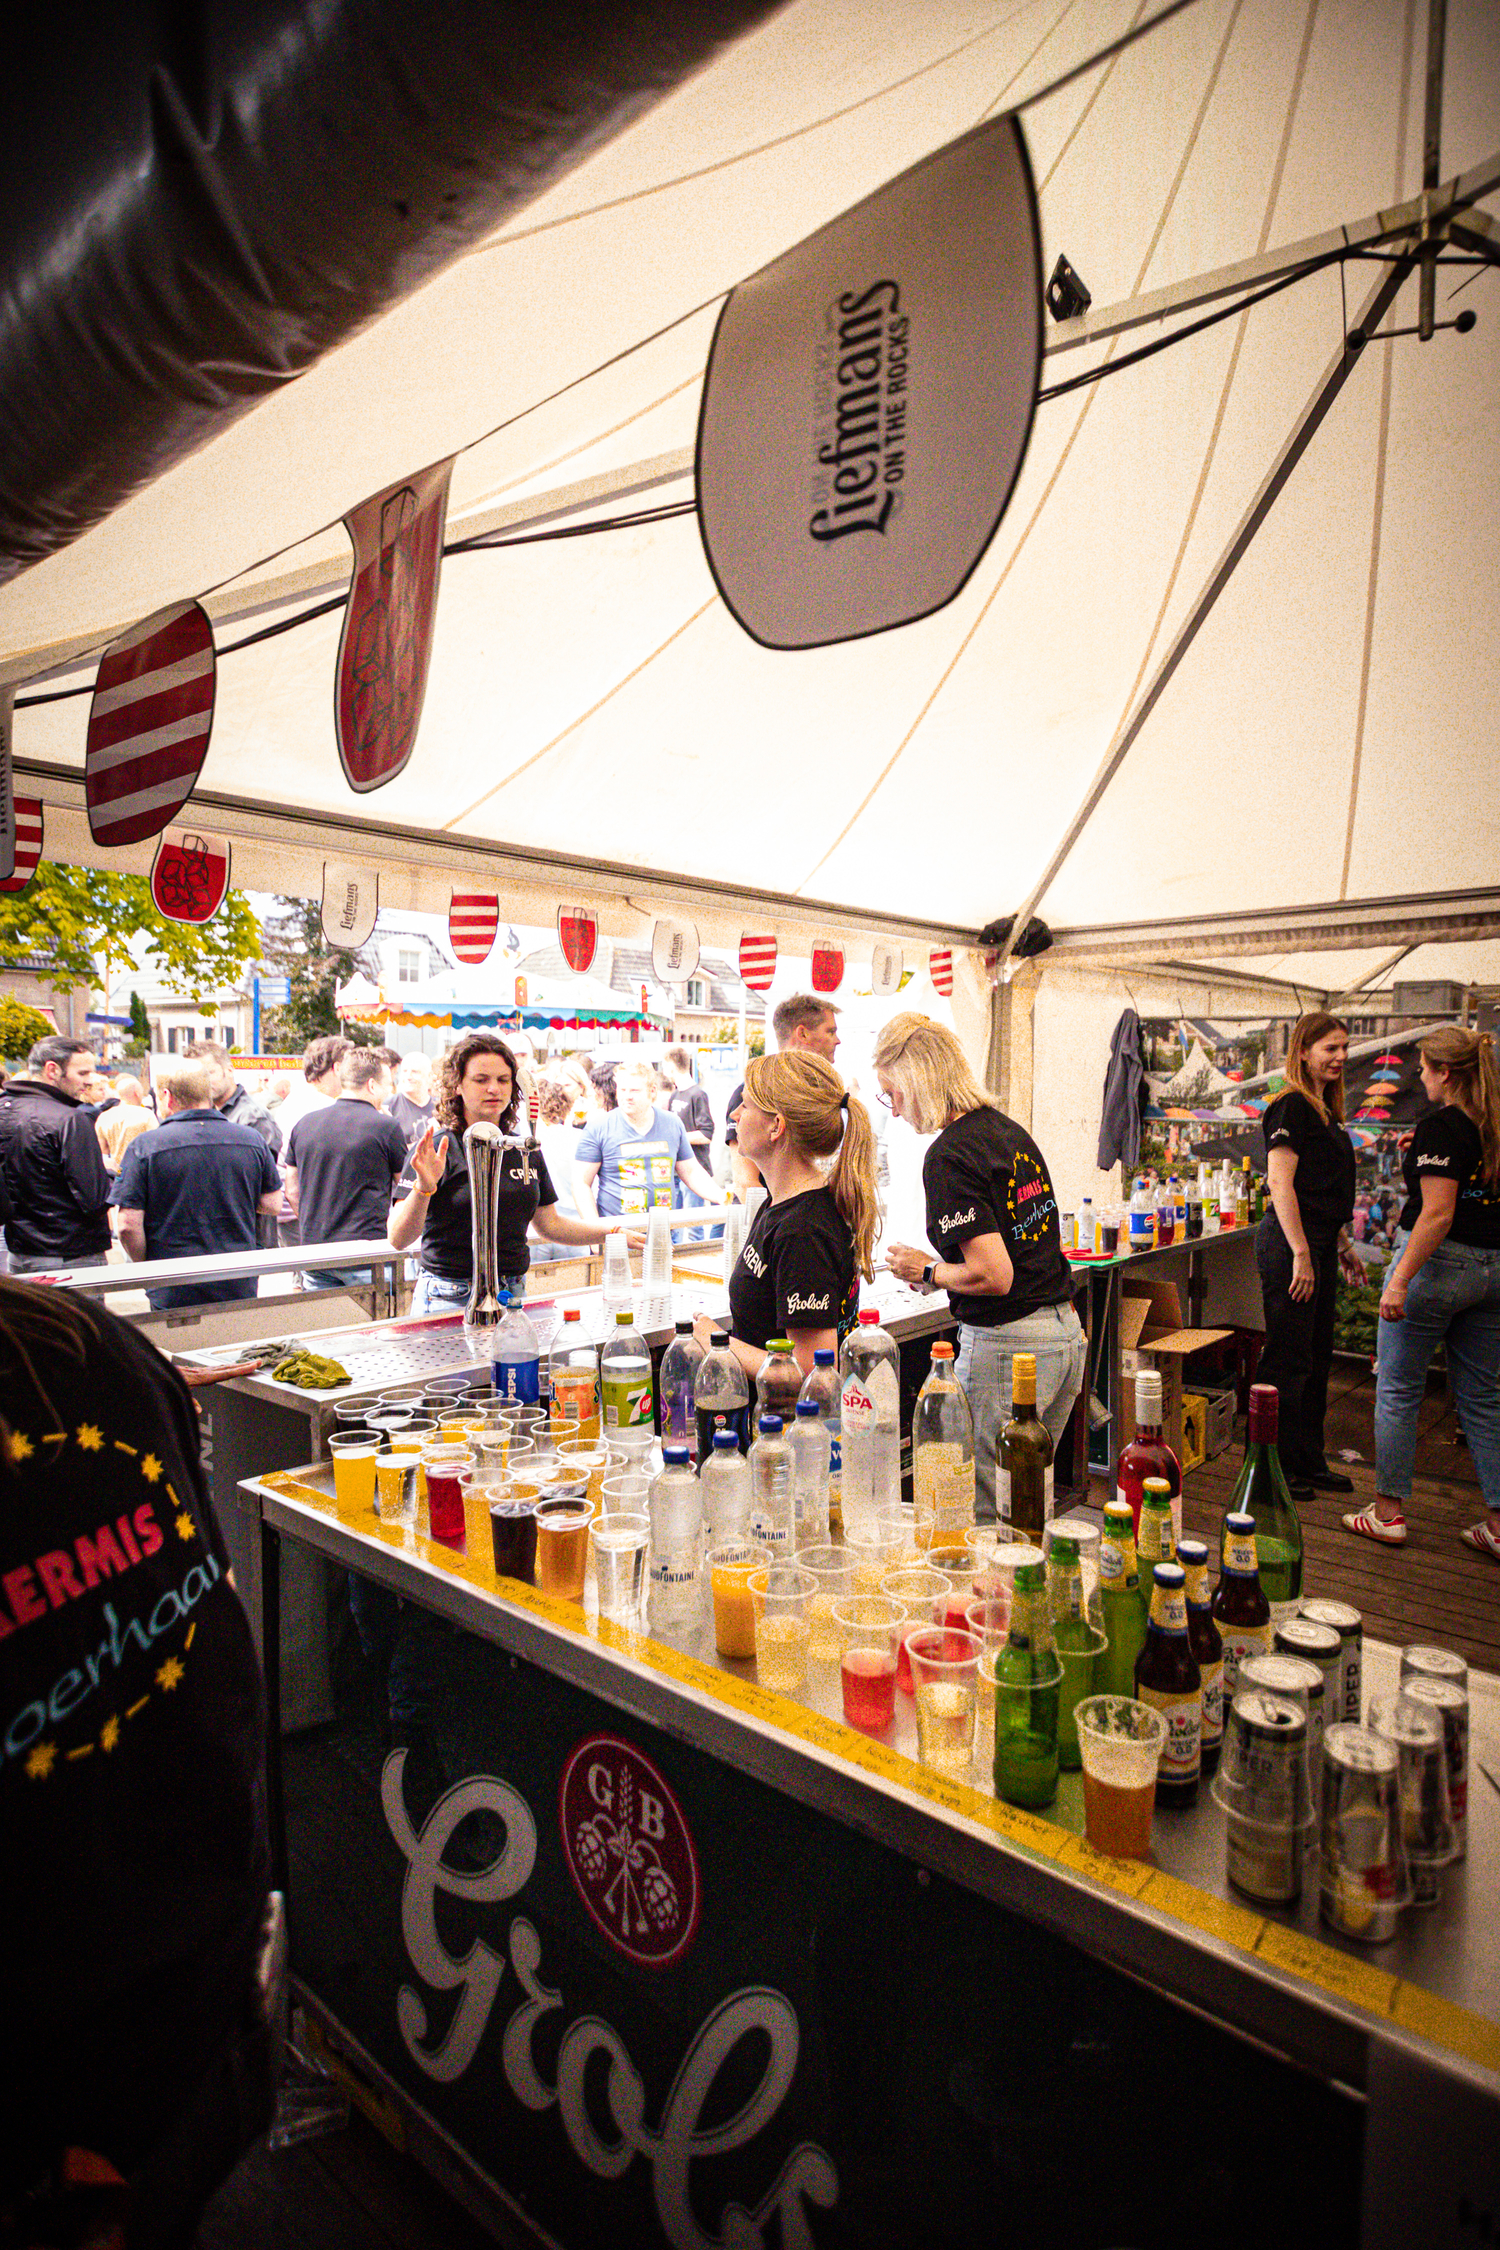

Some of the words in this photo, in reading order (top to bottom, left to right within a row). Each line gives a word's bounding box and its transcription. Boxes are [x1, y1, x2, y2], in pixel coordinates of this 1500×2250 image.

[887, 316, 909, 395] ROCKS
[809, 279, 900, 541] Liefmans
[885, 400, 907, 447] THE
[884, 451, 905, 483] ON
[340, 882, 358, 930] Liefmans
[1416, 1154, 1450, 1167] Grolsch
[939, 1207, 976, 1234] Grolsch
[743, 1244, 768, 1278] CREW
[787, 1292, 830, 1315] Grolsch
[507, 1368, 517, 1400] PEPSI
[842, 1393, 873, 1410] SPA
[1236, 1554, 1250, 1564] 0.0
[588, 1763, 614, 1811] G
[639, 1788, 666, 1841] B
